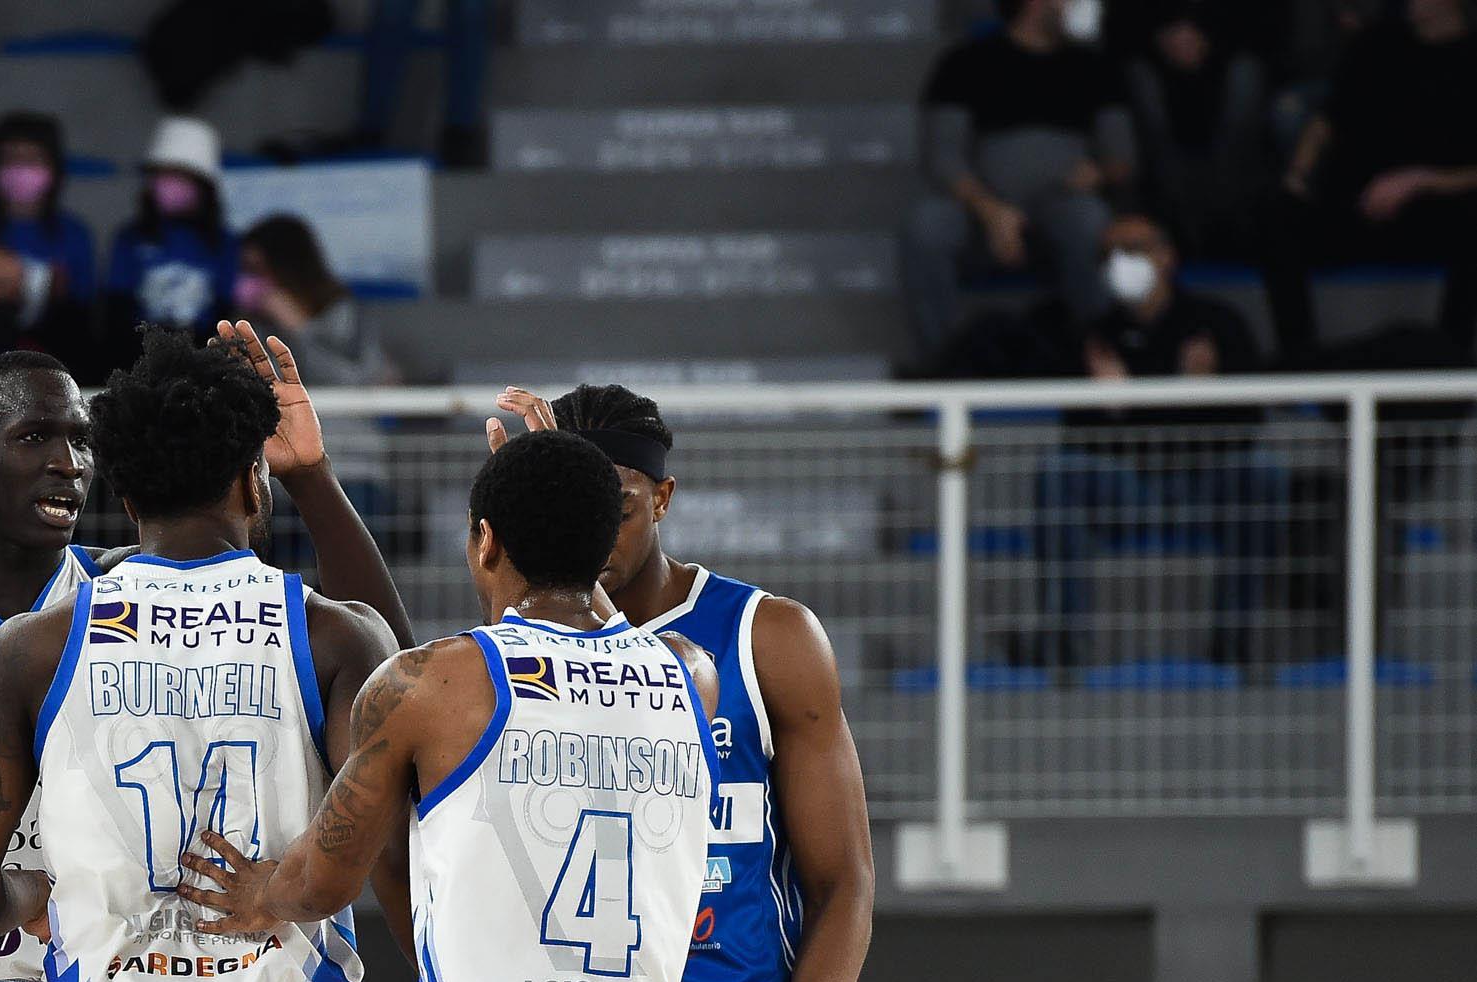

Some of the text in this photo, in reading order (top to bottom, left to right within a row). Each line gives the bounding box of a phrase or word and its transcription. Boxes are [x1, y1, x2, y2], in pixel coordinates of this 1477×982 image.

[151, 601, 283, 630] REALE
[151, 628, 282, 649] MUTUA
[90, 661, 282, 720] BURNELL
[565, 659, 683, 689] REALE
[569, 688, 686, 712] MUTUA
[498, 729, 700, 798] ROBINSON
[114, 740, 261, 892] 14
[539, 808, 642, 979] 4
